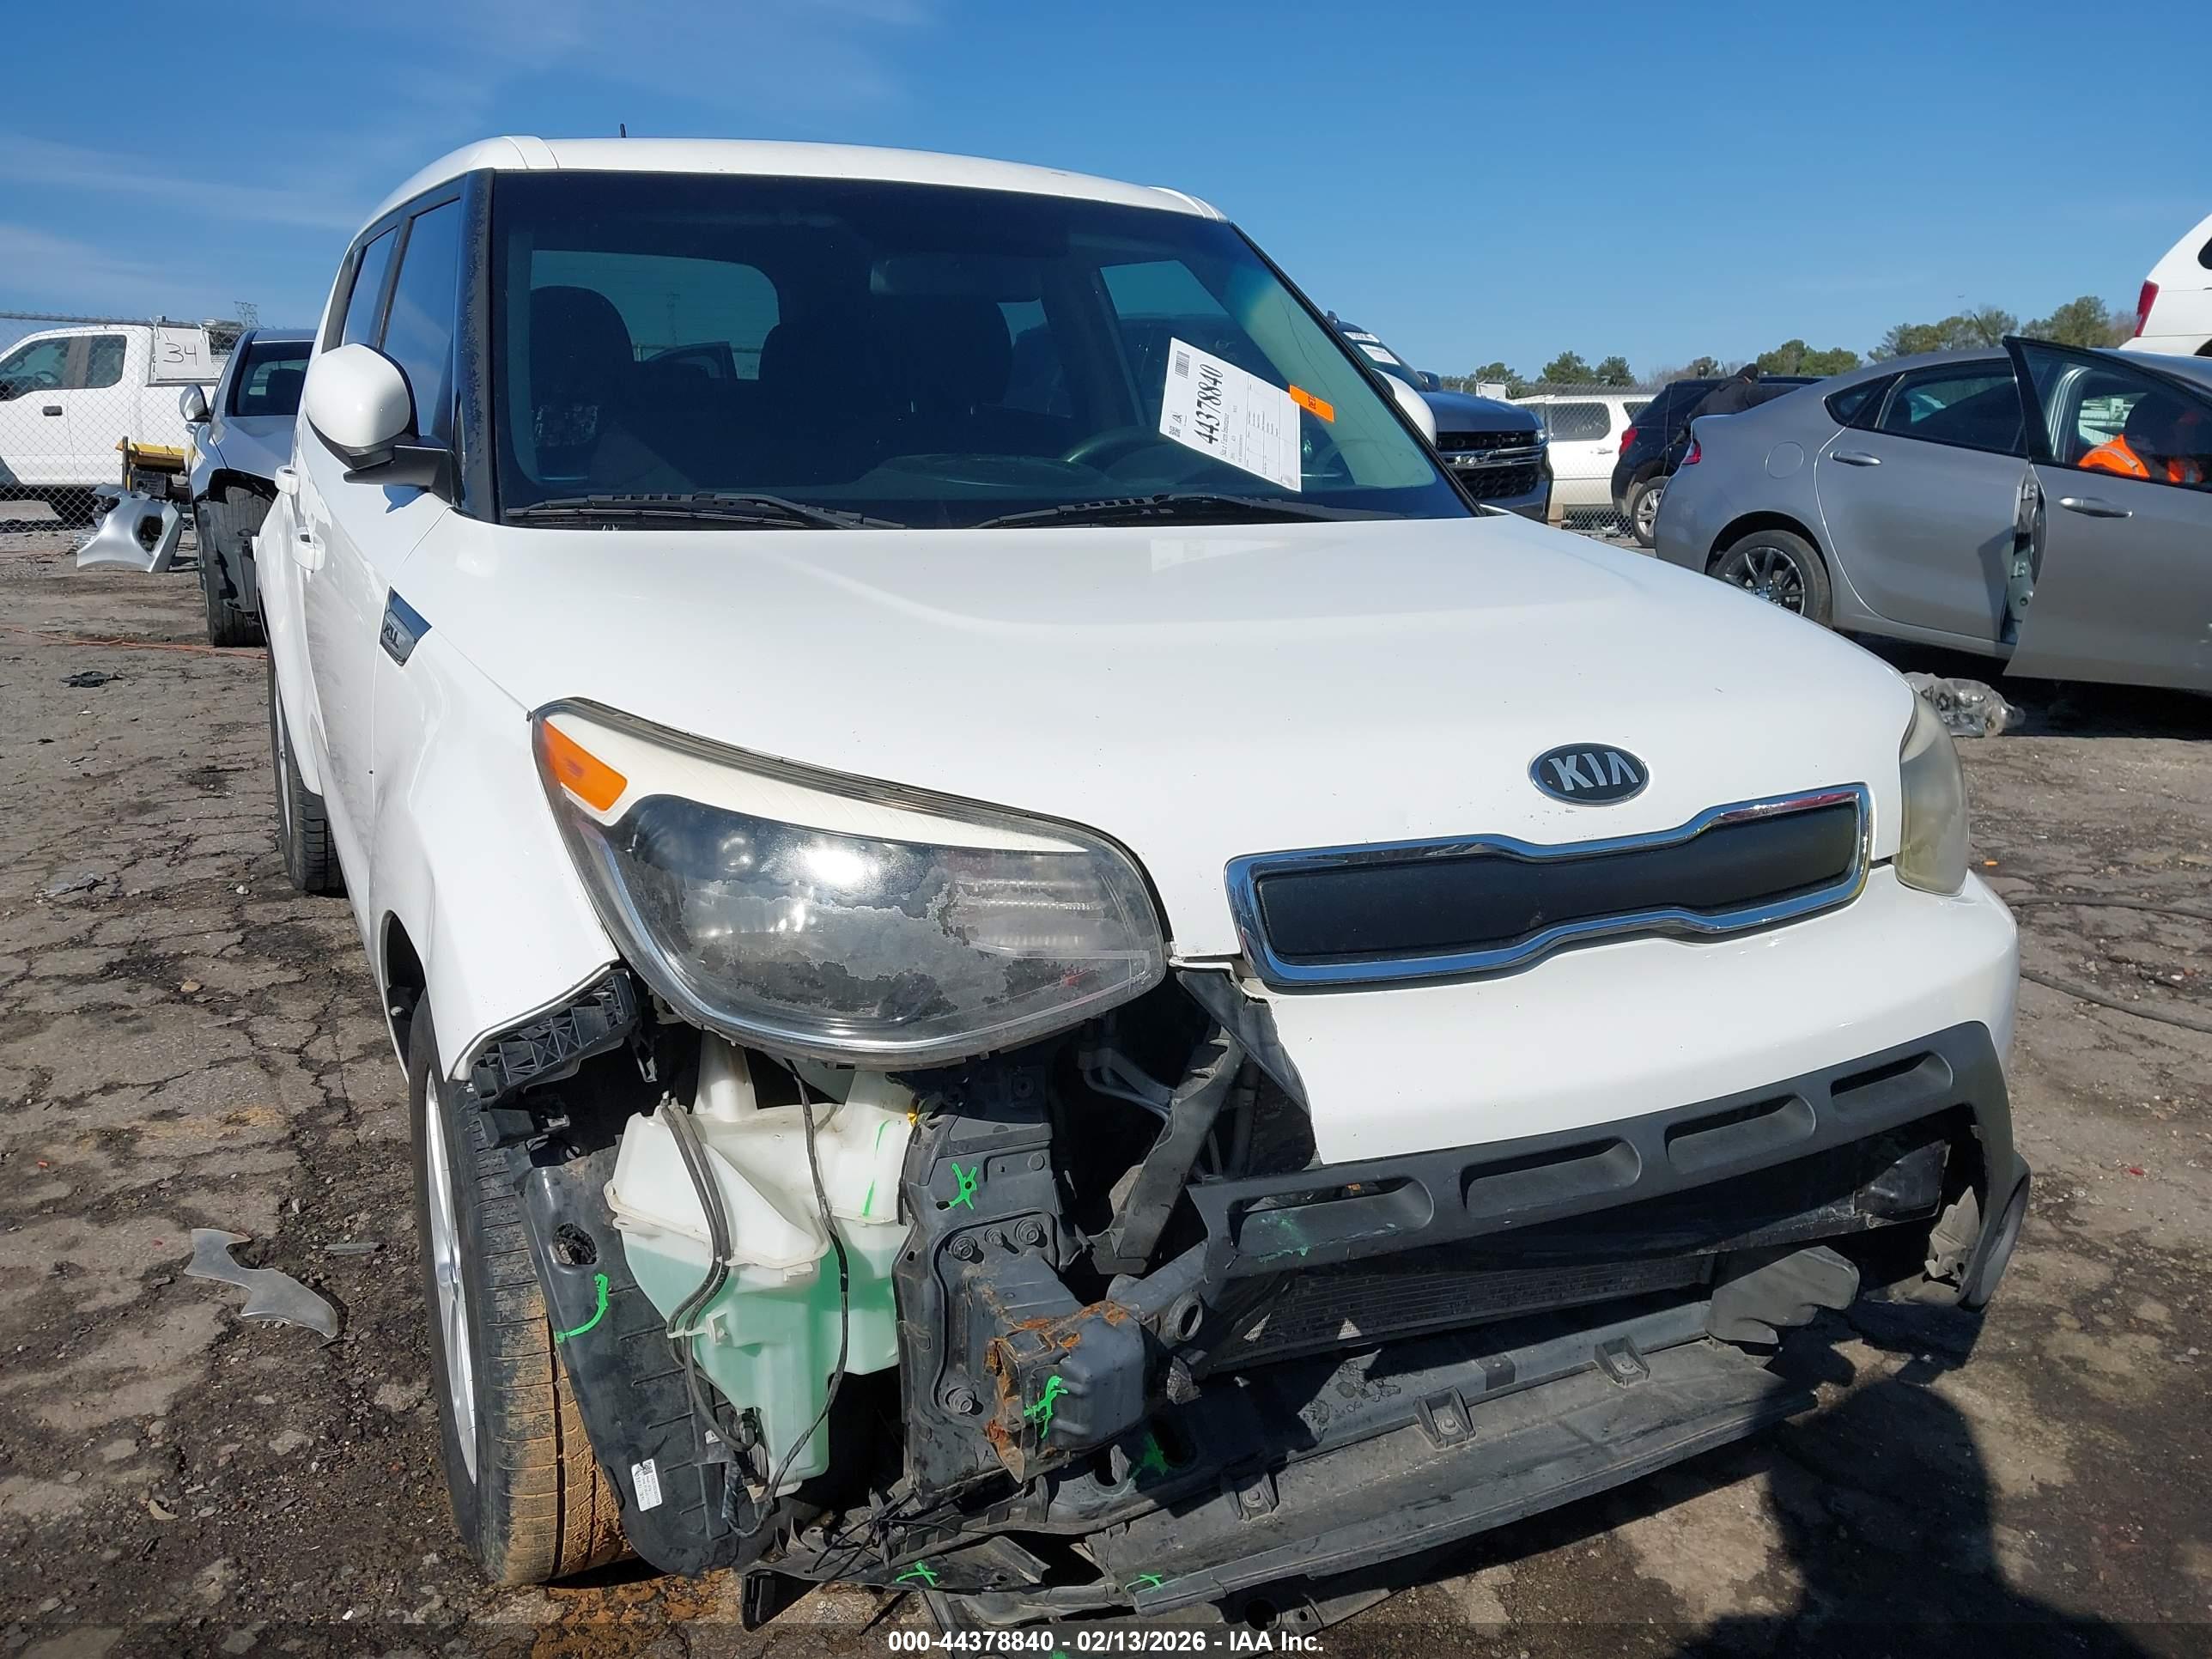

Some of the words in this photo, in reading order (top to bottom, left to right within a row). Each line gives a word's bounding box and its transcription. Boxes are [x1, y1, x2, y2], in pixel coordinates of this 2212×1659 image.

[163, 343, 198, 367] 34
[1194, 363, 1223, 445] 44378840
[1548, 751, 1639, 791] KIA
